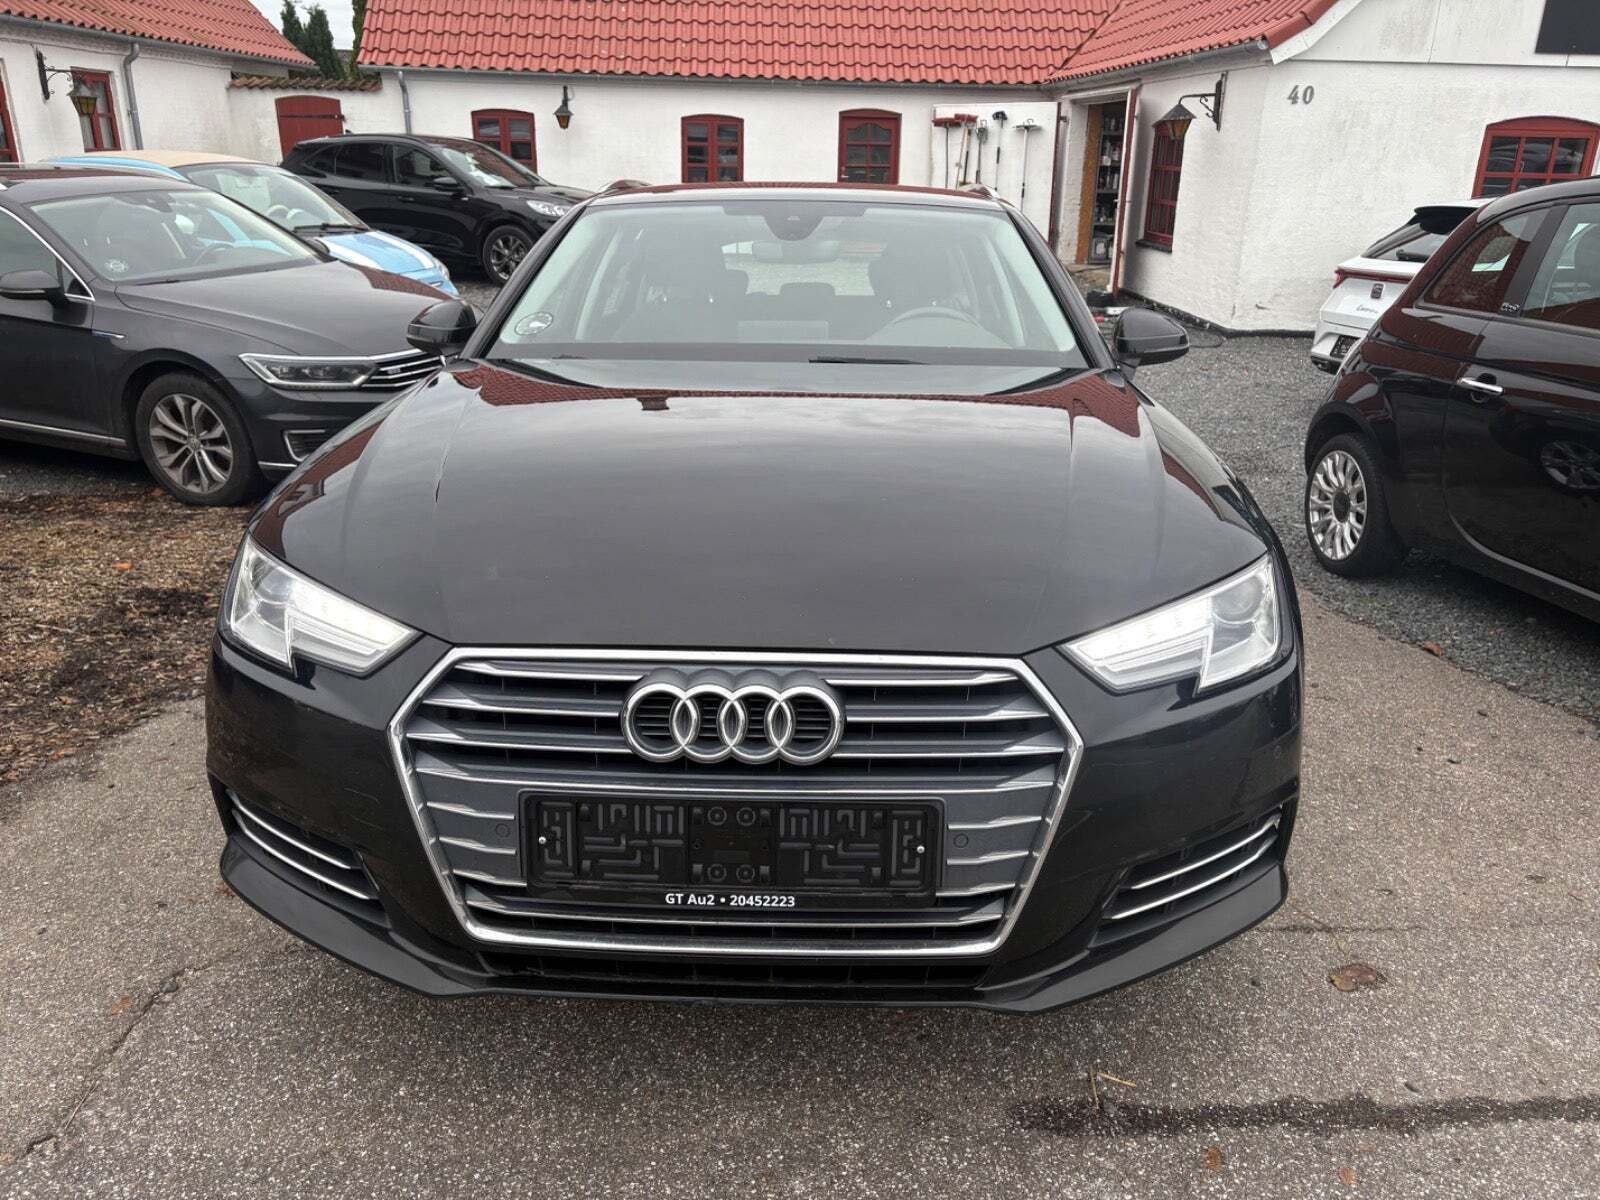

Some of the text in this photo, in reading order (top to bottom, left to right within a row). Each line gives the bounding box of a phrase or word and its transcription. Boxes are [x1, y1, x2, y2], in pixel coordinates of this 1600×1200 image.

[1287, 84, 1315, 105] 40
[665, 893, 796, 907] GT Au2 20452223
